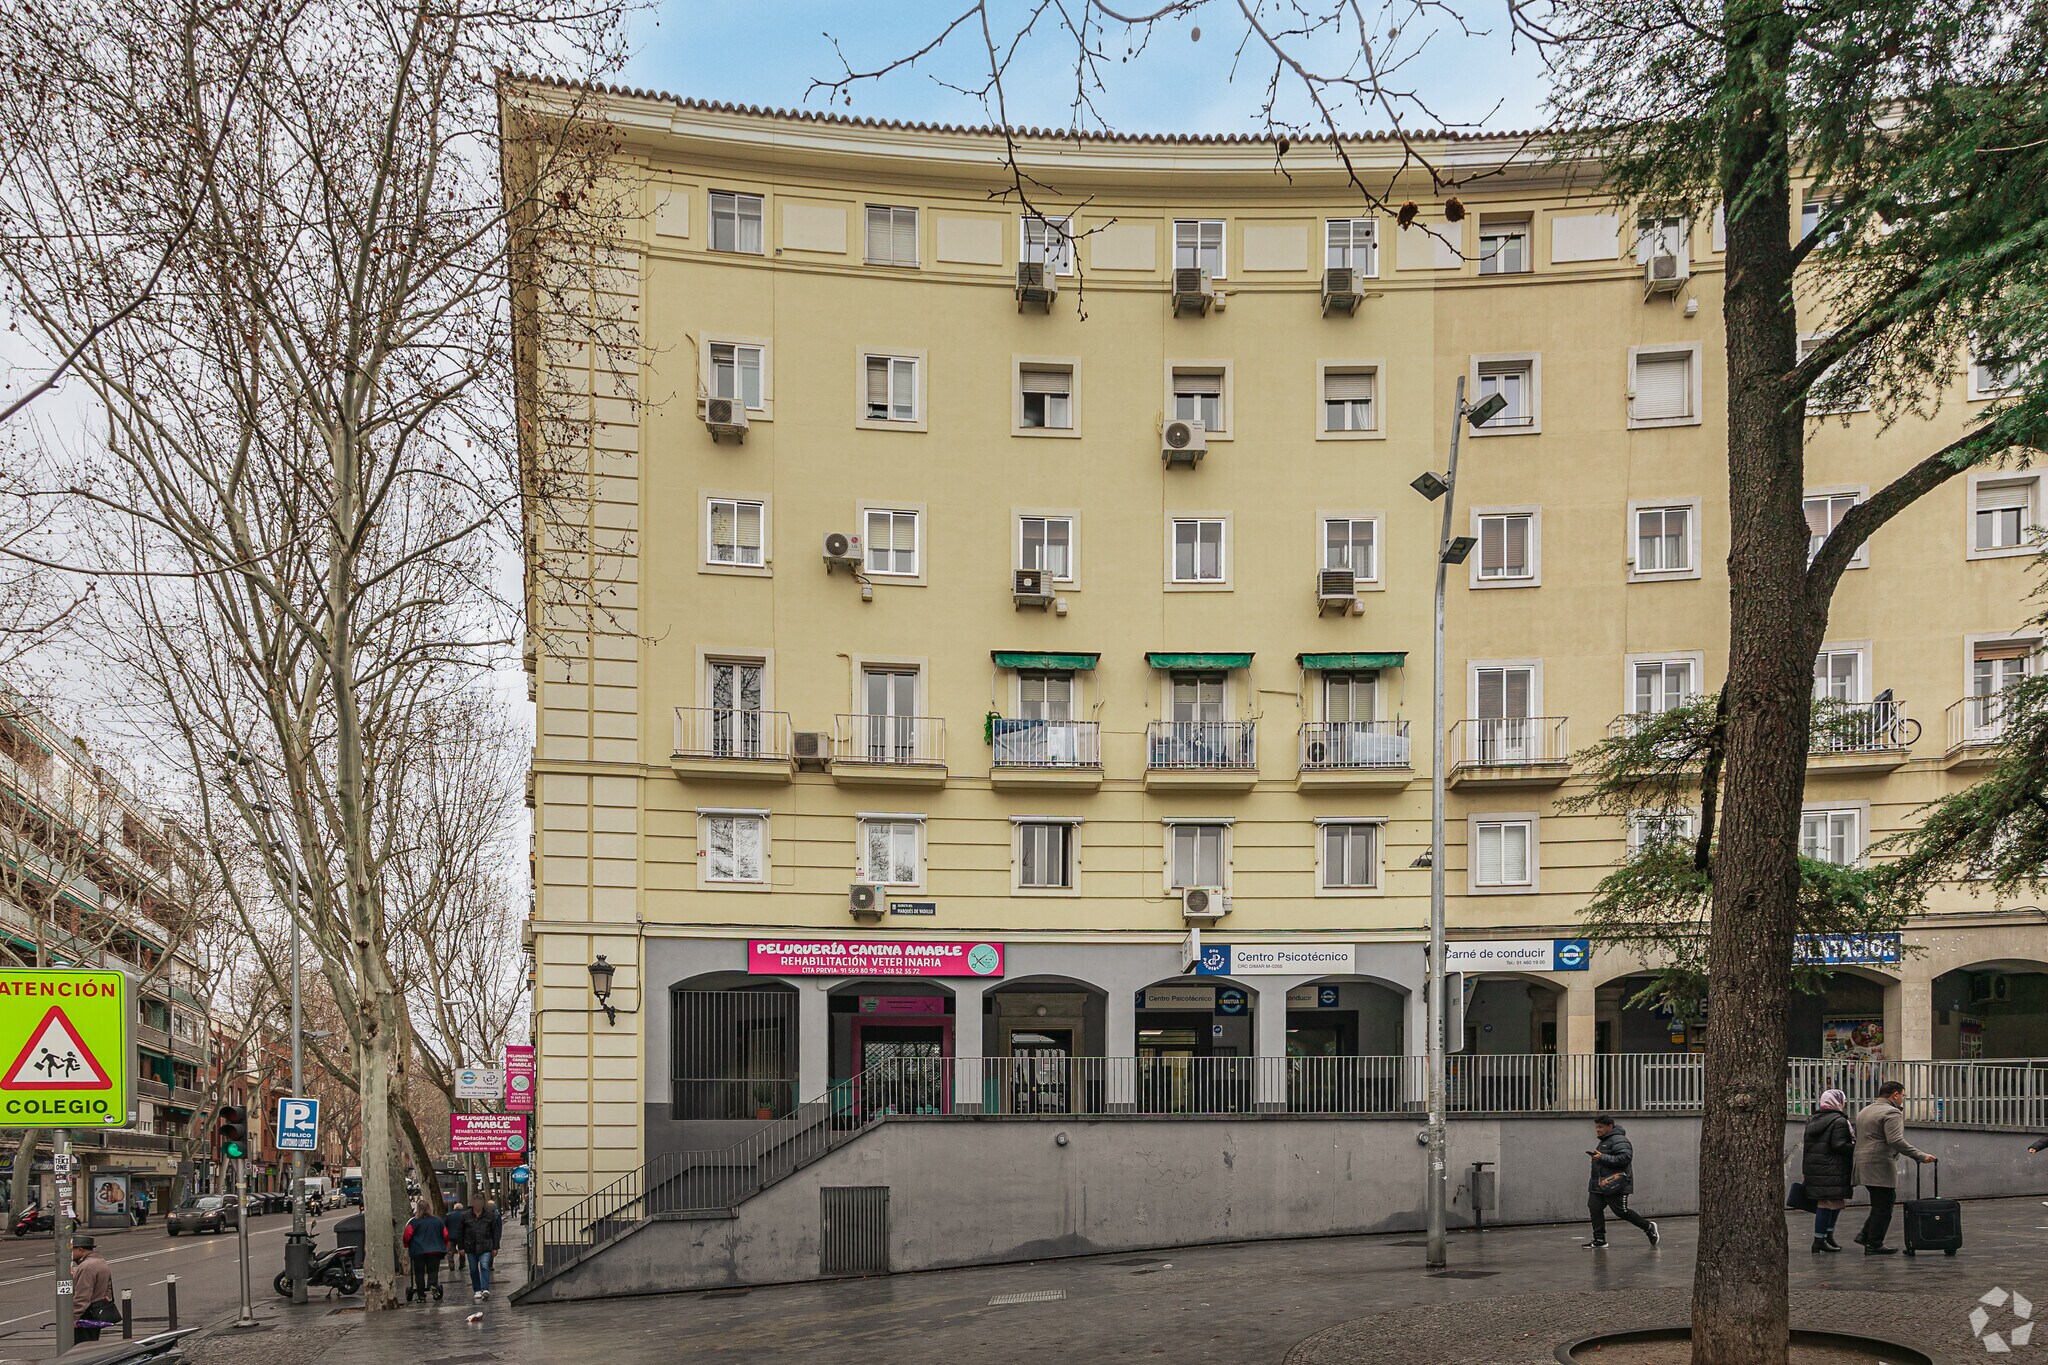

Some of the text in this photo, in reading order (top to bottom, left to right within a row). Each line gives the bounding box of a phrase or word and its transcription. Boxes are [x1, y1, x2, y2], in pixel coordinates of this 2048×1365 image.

[757, 942, 962, 956] PELUQUERÍA CANINA AMABLE
[1446, 948, 1545, 958] Carné de conducir
[781, 956, 866, 966] REHABILITACIÓN
[1237, 951, 1348, 962] Centro Psicotécnico
[0, 979, 114, 997] ATENCIÓN
[6, 1100, 108, 1114] COLEGIO
[285, 1104, 310, 1128] P
